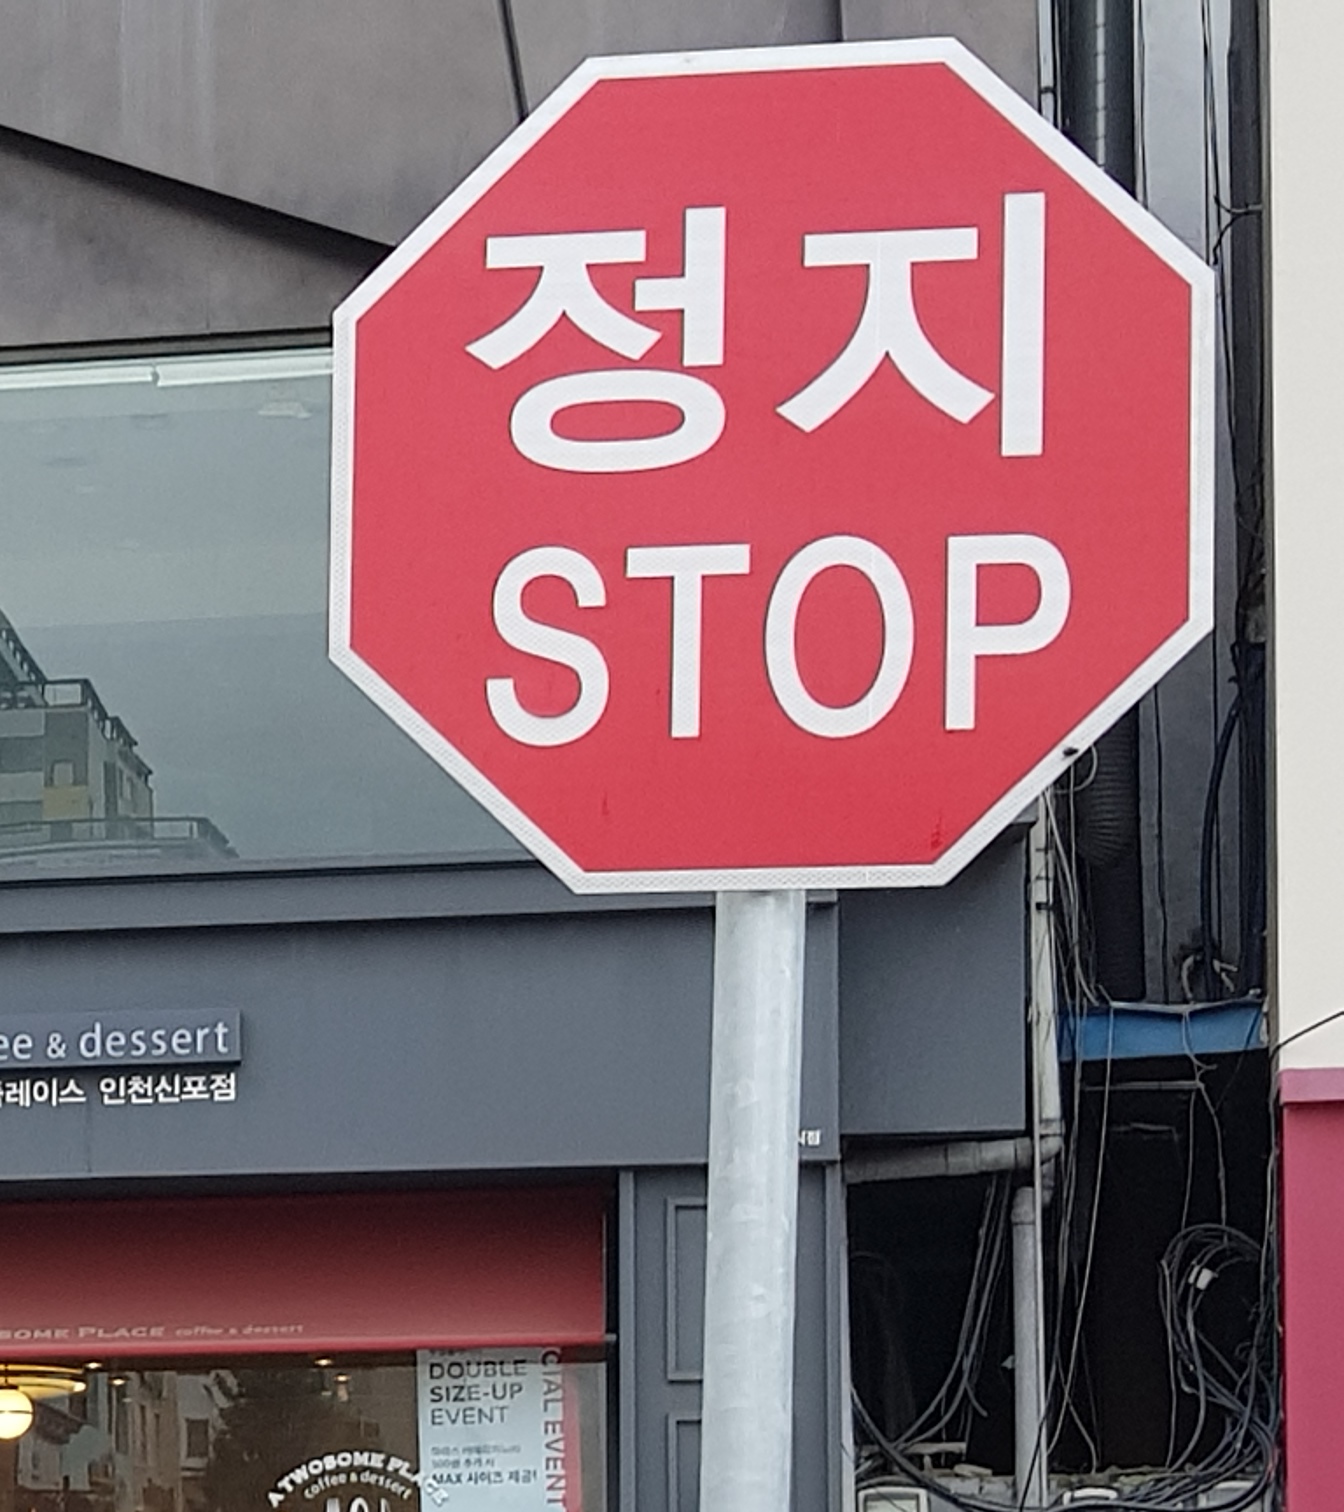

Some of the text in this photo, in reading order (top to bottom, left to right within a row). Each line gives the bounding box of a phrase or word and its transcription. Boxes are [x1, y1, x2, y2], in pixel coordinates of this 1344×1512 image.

[465, 191, 1047, 474] 정지
[485, 532, 1072, 748] STOP
[46, 1034, 67, 1058] &
[79, 1021, 229, 1058] dessert
[99, 1071, 237, 1106] 인천신포점
[429, 1359, 528, 1380] DOUBLE
[429, 1381, 524, 1403] SIZE-UP
[431, 1406, 510, 1426] EVENT
[544, 1420, 567, 1508] EVENT
